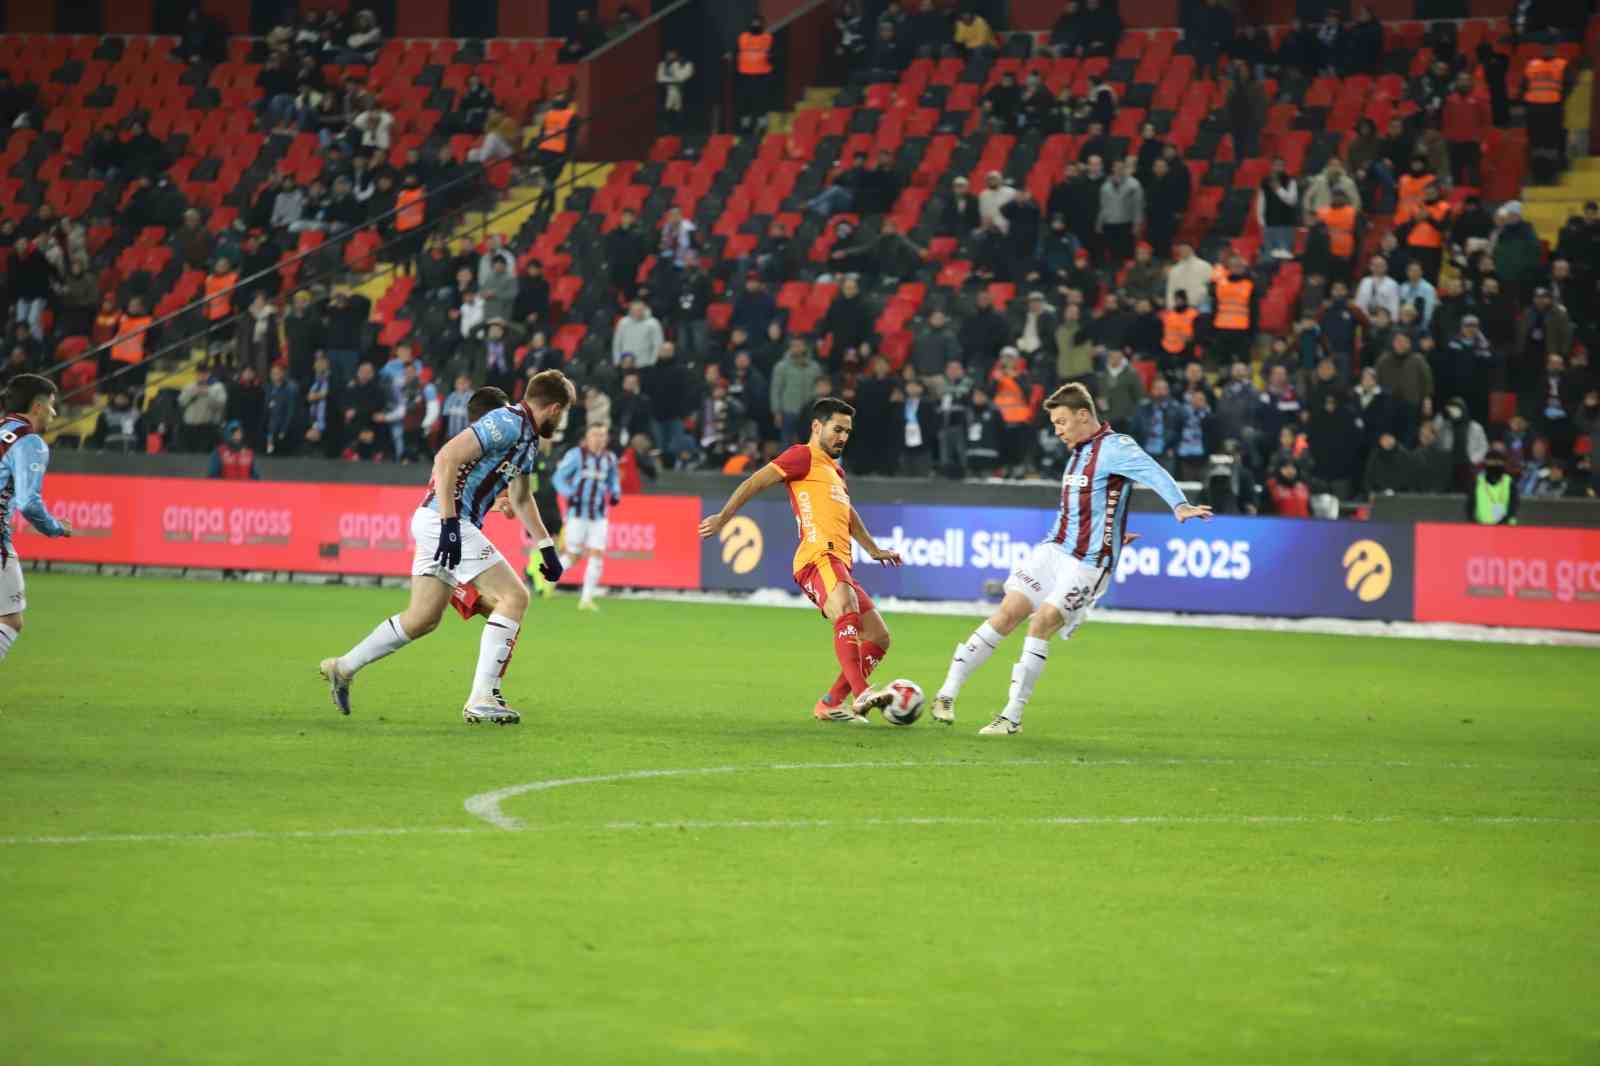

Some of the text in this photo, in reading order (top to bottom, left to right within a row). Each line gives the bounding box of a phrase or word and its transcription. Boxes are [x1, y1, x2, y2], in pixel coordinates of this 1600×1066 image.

[163, 506, 292, 544] anpa gross
[339, 512, 401, 550] anpa
[607, 523, 657, 551] ross
[1115, 546, 1161, 583] pa
[1166, 538, 1251, 580] 2025
[1465, 556, 1547, 595] anpa
